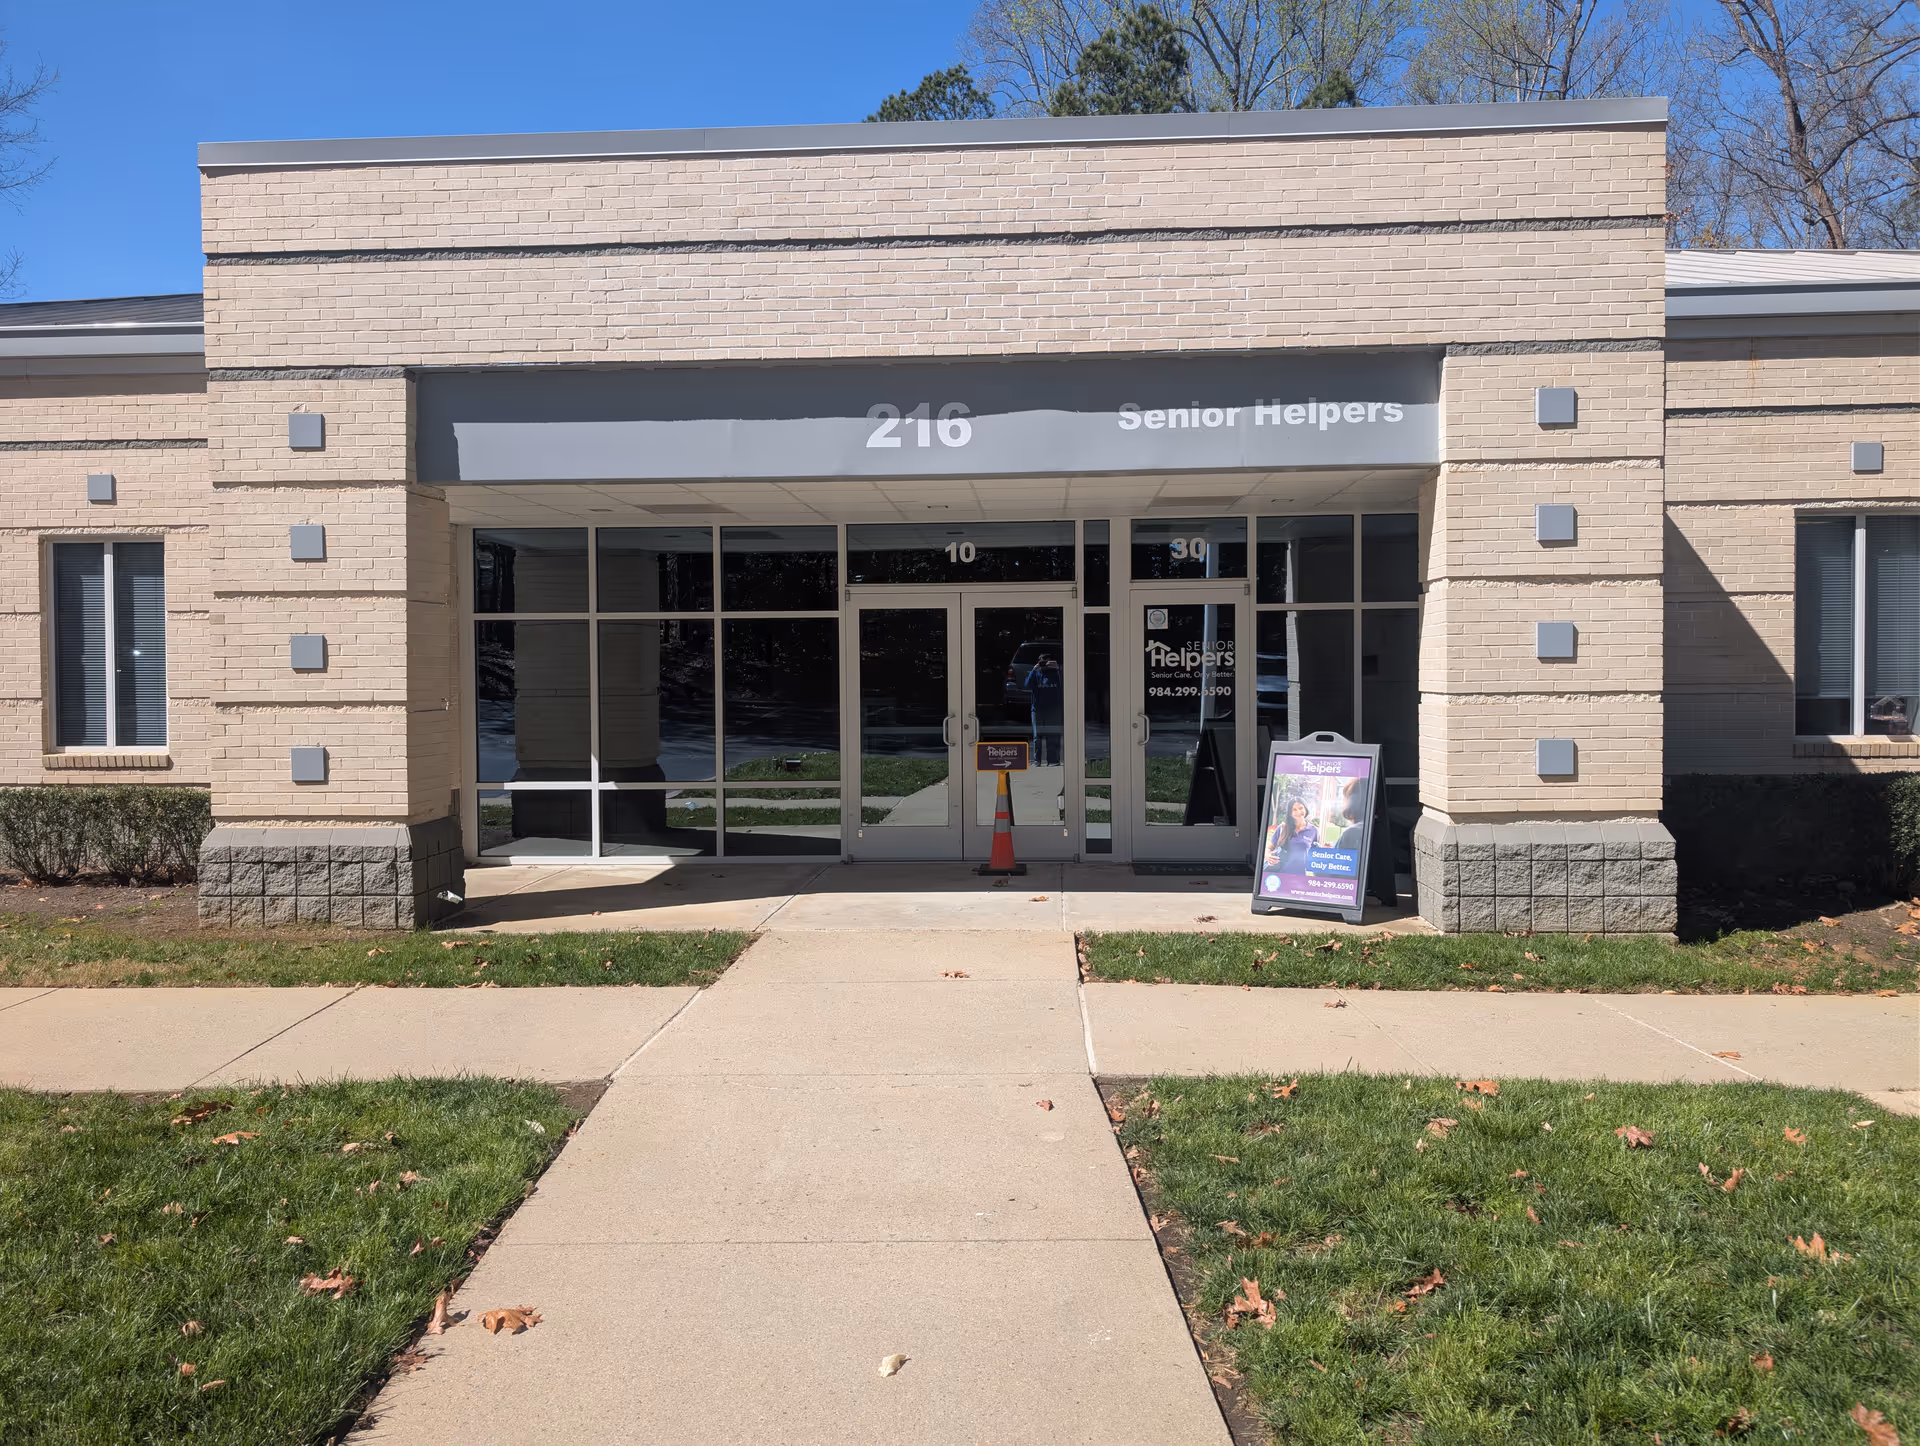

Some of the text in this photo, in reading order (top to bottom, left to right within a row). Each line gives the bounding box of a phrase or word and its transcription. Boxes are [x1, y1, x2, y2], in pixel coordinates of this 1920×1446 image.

[1118, 397, 1404, 431] Senior Helpers
[866, 402, 972, 447] 216
[945, 541, 976, 563] 10
[1171, 537, 1207, 560] 30
[1186, 640, 1234, 651] SENIOR
[1151, 647, 1235, 671] Helpers
[1151, 671, 1173, 679] Senior
[1174, 671, 1192, 679] Care,
[1148, 686, 1232, 697] 984.299.6590
[988, 748, 1018, 757] Helpers
[1303, 763, 1341, 774] Helpers
[1312, 851, 1352, 861] Senior Care,
[1311, 861, 1351, 871] Only Better.
[1307, 879, 1354, 890] 984-299.6590
[1290, 889, 1354, 900] www.seniorhelpers.com
